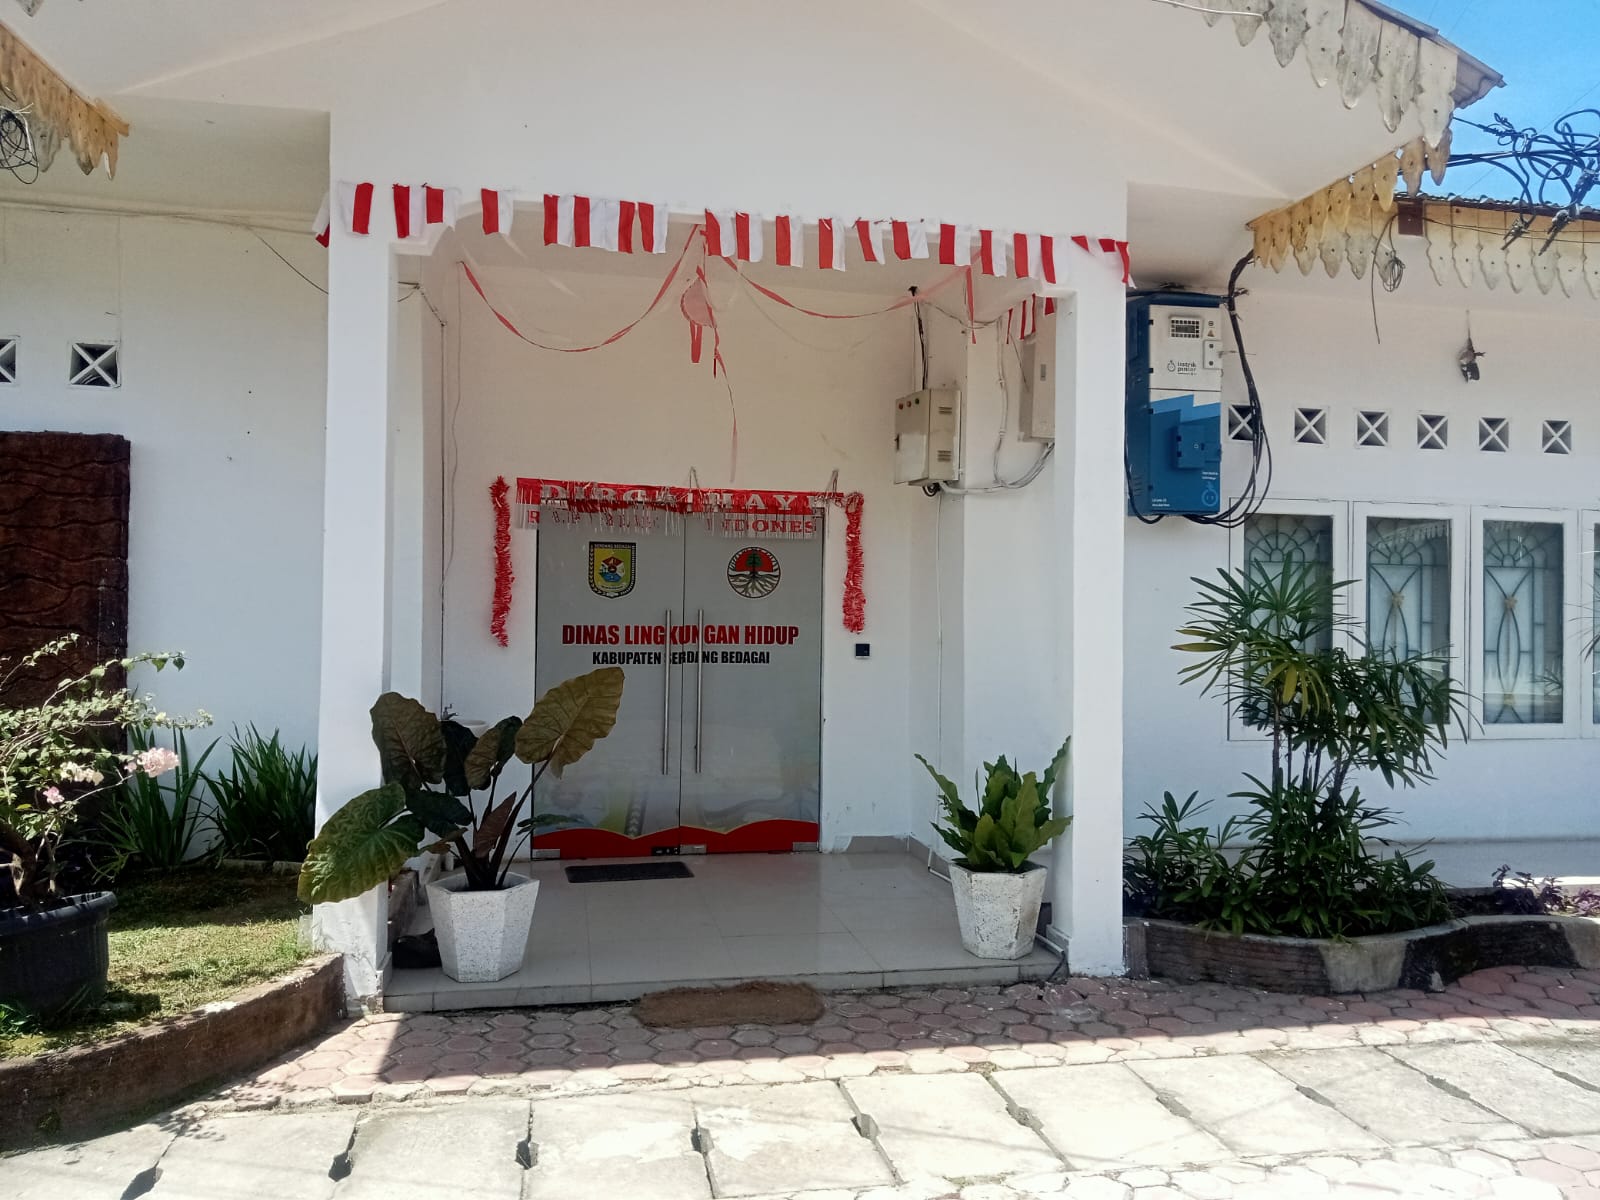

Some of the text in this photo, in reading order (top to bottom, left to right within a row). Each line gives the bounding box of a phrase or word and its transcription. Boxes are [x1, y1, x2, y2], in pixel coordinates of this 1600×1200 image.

[562, 625, 799, 645] DINAS LINGKUNGAN HIDUP
[592, 651, 770, 665] KABUPATEN ERDNG BEDAGAI
